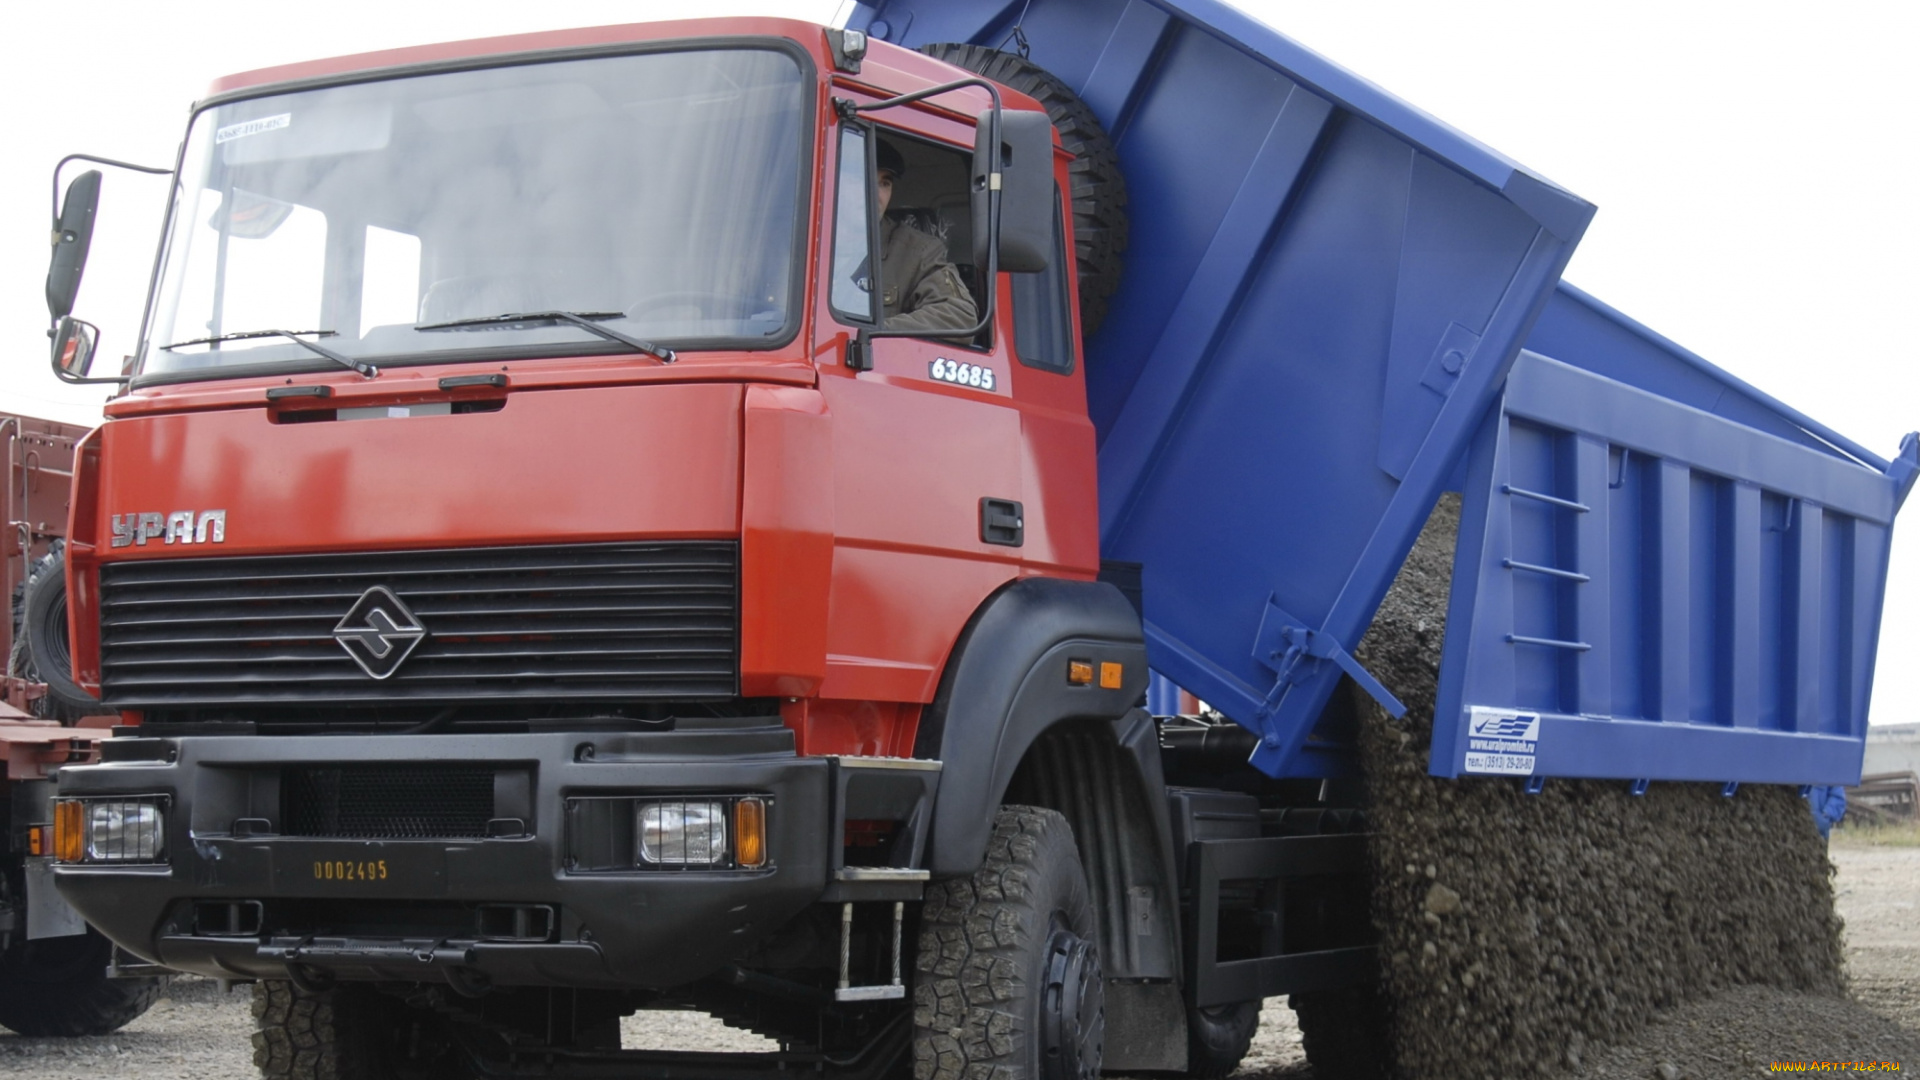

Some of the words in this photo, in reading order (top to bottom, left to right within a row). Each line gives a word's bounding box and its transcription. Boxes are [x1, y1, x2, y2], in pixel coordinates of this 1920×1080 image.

[930, 356, 993, 389] 63685
[111, 509, 227, 548] УРАЛ
[314, 860, 387, 880] 0002495
